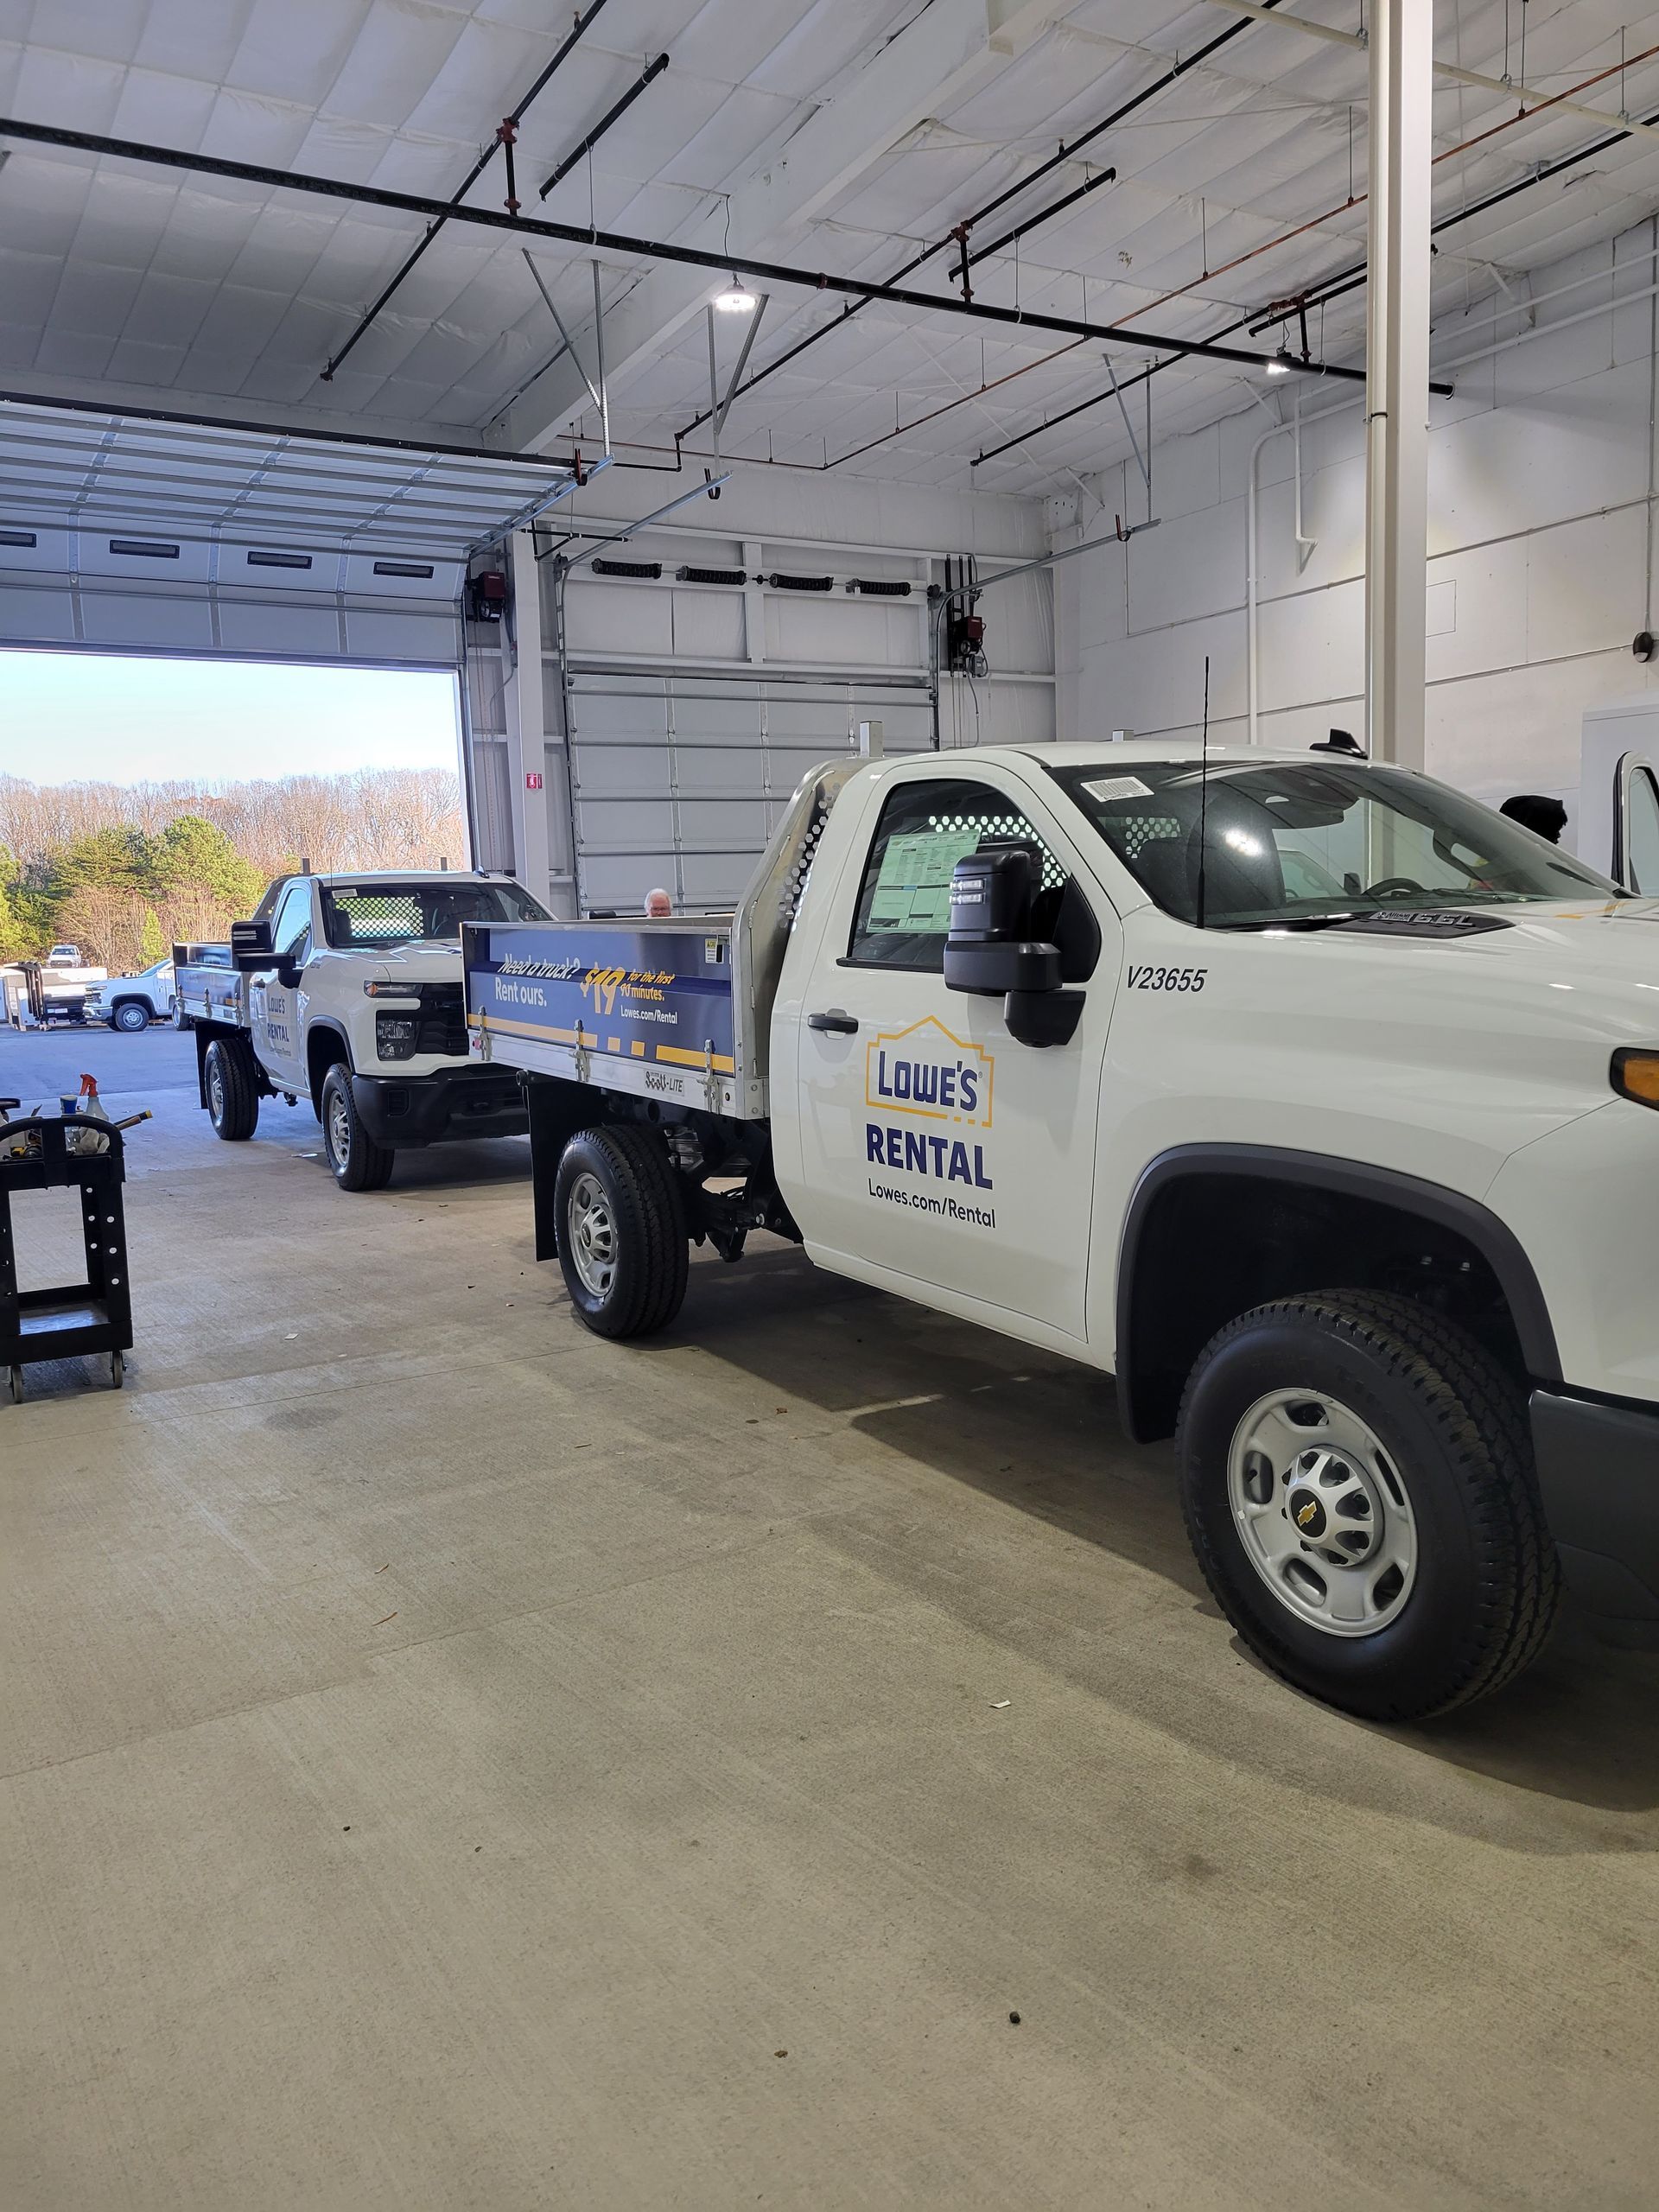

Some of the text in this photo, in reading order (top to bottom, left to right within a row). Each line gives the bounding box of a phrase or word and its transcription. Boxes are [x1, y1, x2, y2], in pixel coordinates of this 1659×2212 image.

[1413, 913, 1473, 925] 6.6L
[498, 953, 581, 980] Need a truck?
[627, 968, 676, 985] for the first
[1128, 965, 1209, 993] V23655
[495, 976, 547, 1007] Rent ours.
[580, 961, 626, 1015] $19
[620, 983, 665, 1001] 90 minutes.
[268, 994, 286, 1014] LOWE'S
[620, 1004, 678, 1025] Lowes.com/Rental
[267, 1022, 290, 1043] RENTAL
[878, 1050, 978, 1112] LOWE'S
[866, 1122, 994, 1191] RENTAL
[868, 1177, 996, 1229] Lowes.com/Rental
